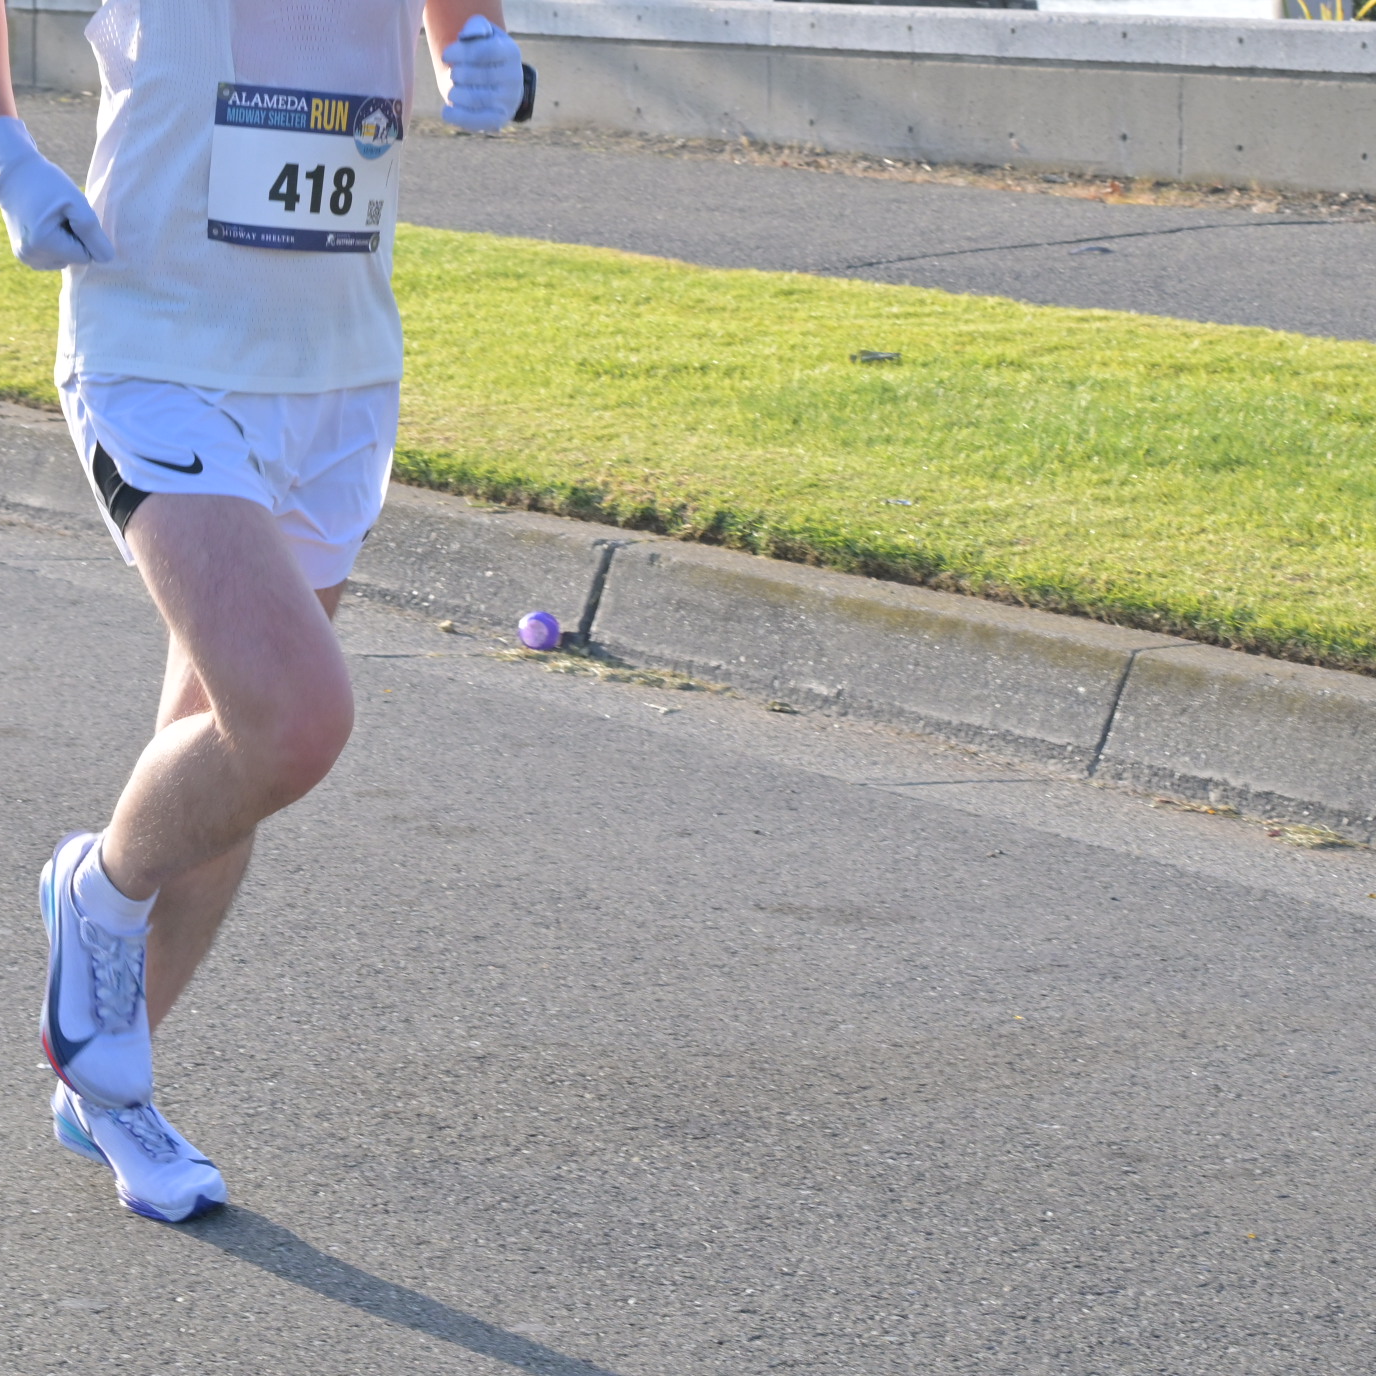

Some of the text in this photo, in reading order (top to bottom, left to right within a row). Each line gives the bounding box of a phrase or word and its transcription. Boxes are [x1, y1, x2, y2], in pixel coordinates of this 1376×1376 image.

[228, 91, 308, 112] ALAMEDA
[226, 106, 307, 128] MIDWAY SHELTER
[310, 97, 349, 132] RUN
[268, 162, 356, 216] 418
[261, 233, 295, 244] SHELTER
